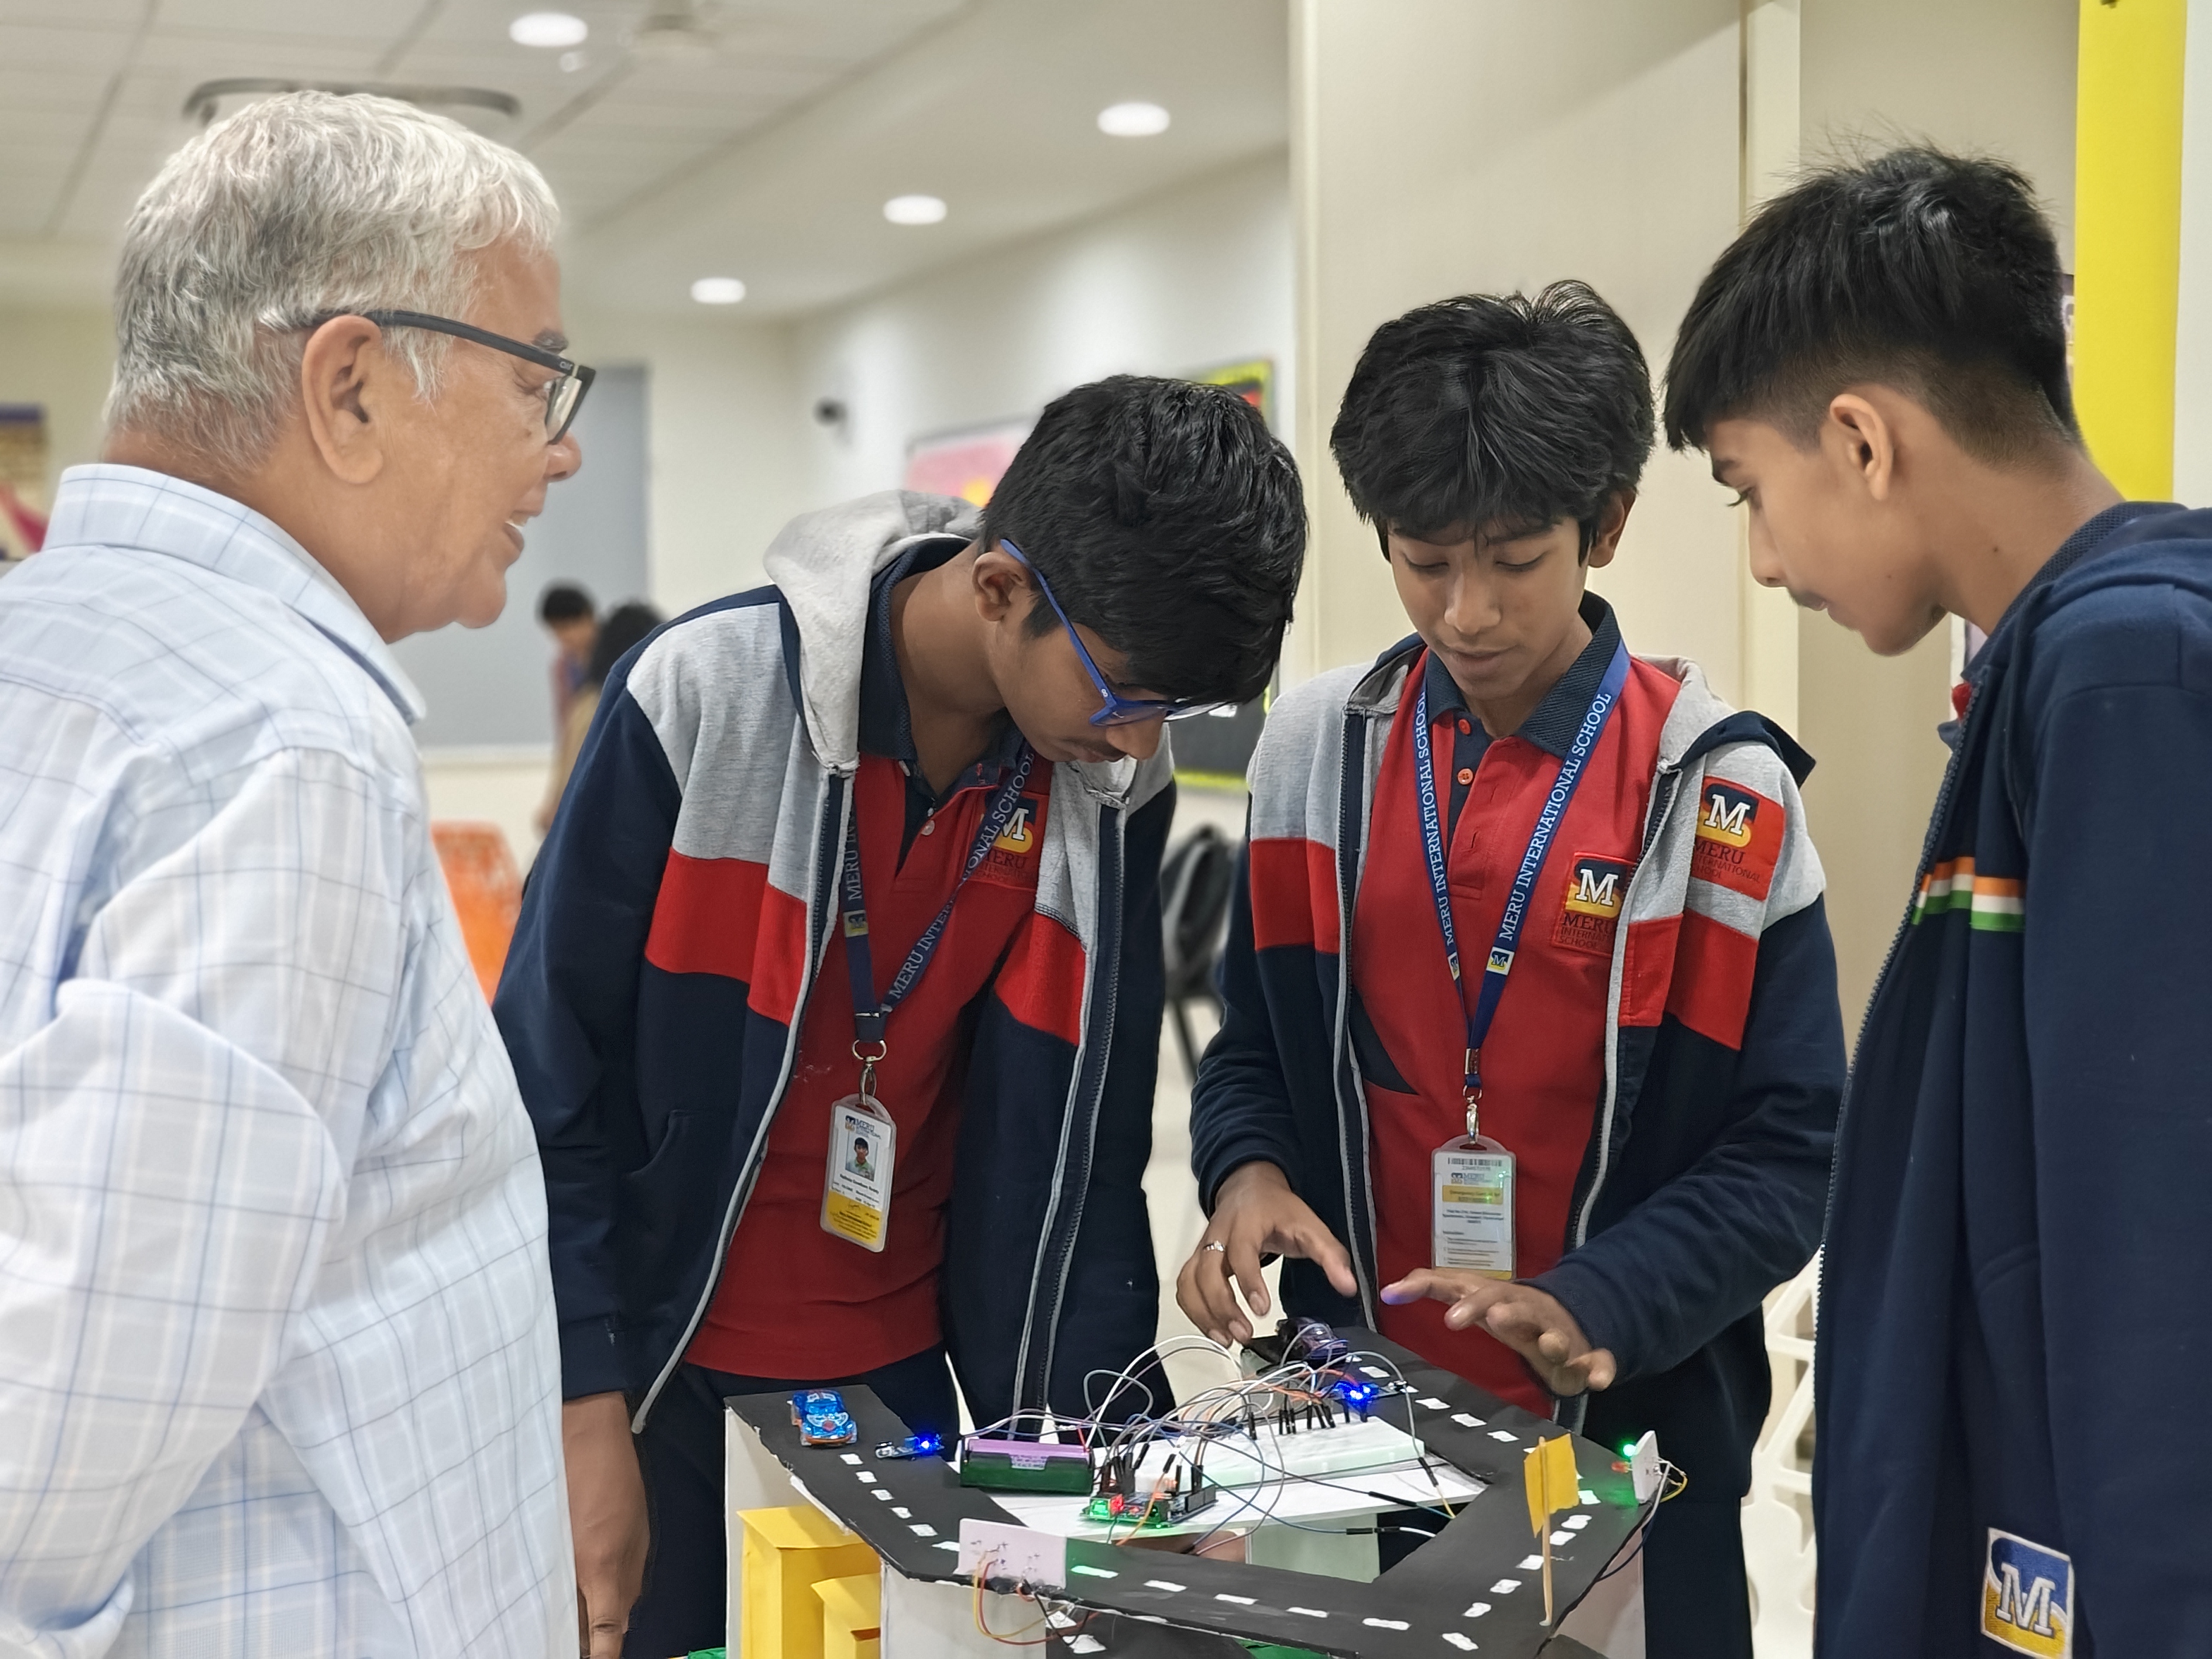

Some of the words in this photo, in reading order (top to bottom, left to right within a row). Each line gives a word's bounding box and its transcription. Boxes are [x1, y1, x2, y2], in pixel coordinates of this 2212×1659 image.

[1420, 759, 1447, 893] INTERNATIONAL
[1499, 889, 1526, 941] MERU
[1516, 758, 1581, 888] INTERNATIONAL
[1572, 693, 1612, 756] SCHOOL
[1704, 794, 1751, 836] M
[846, 850, 863, 901] MERU
[889, 949, 924, 999] MERU
[992, 753, 1035, 823] SCHOOL
[1575, 868, 1619, 906] M
[1438, 897, 1454, 946] MERU
[1492, 954, 1506, 967] M
[1995, 1562, 2056, 1636] M
